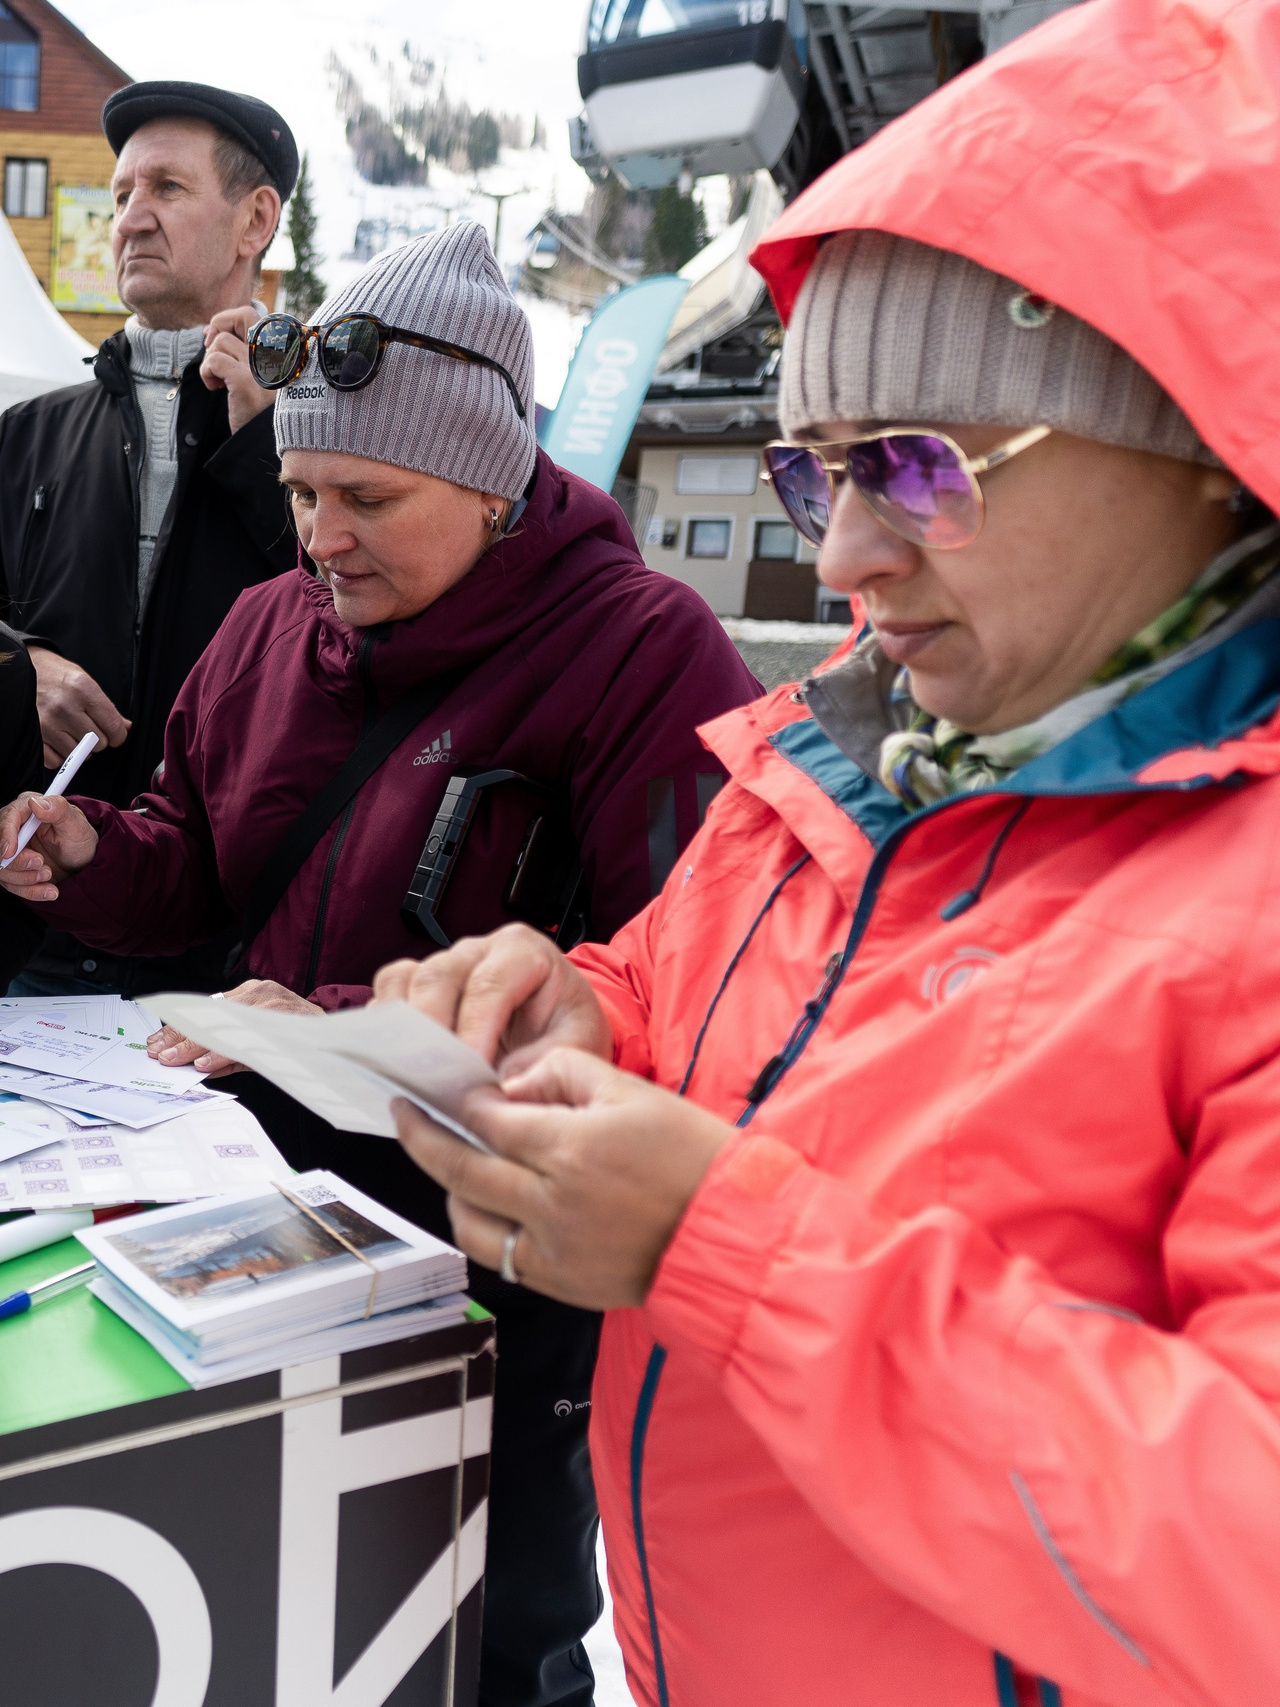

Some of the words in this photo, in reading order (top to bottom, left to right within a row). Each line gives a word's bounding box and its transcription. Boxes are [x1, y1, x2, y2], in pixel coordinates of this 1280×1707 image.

[287, 385, 326, 399] Reebok
[564, 337, 639, 455] ИНФО
[412, 750, 459, 766] adidas
